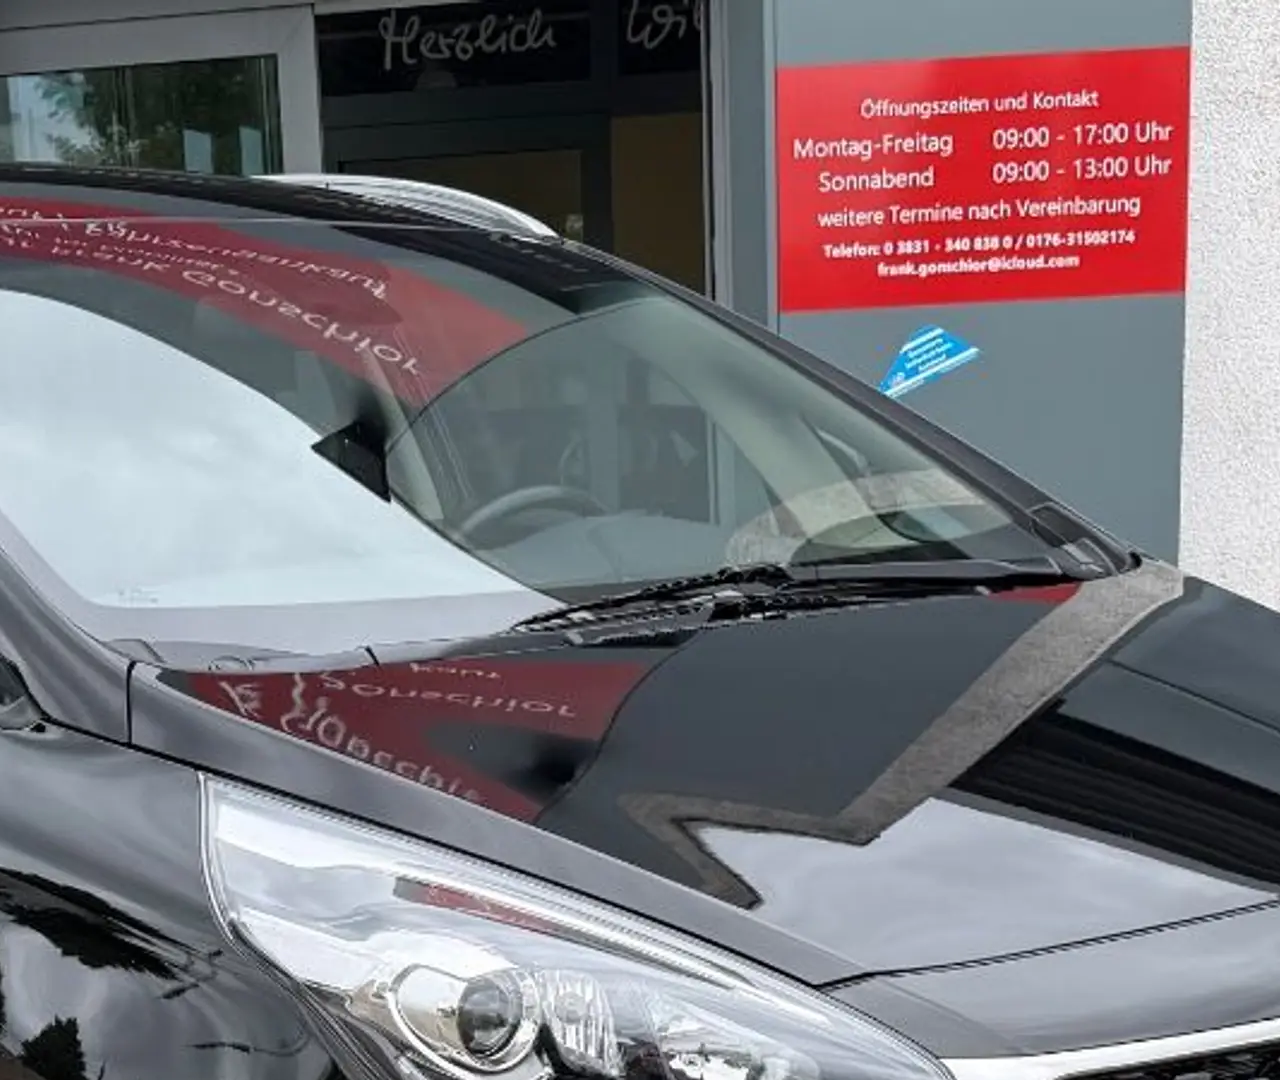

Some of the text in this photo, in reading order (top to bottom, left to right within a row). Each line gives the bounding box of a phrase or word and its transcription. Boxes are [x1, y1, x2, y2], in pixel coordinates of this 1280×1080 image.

[378, 9, 556, 69] Herzlich
[860, 88, 1099, 119] Öffnungszeiten und Kontakt
[793, 132, 954, 161] Montag-Freitag
[993, 126, 1050, 150] 09:00
[1073, 122, 1129, 146] 17:00
[1135, 120, 1174, 143] Uhr
[819, 165, 934, 193] Sonnabend
[993, 160, 1050, 184] 09:00
[1073, 155, 1129, 180] 13:00
[1135, 153, 1173, 177] Uhr
[817, 196, 1141, 227] weitere Termine nach Vereinbarung
[823, 241, 881, 258] Telefon:
[877, 254, 1081, 278] frank.gonschior@icloud.com
